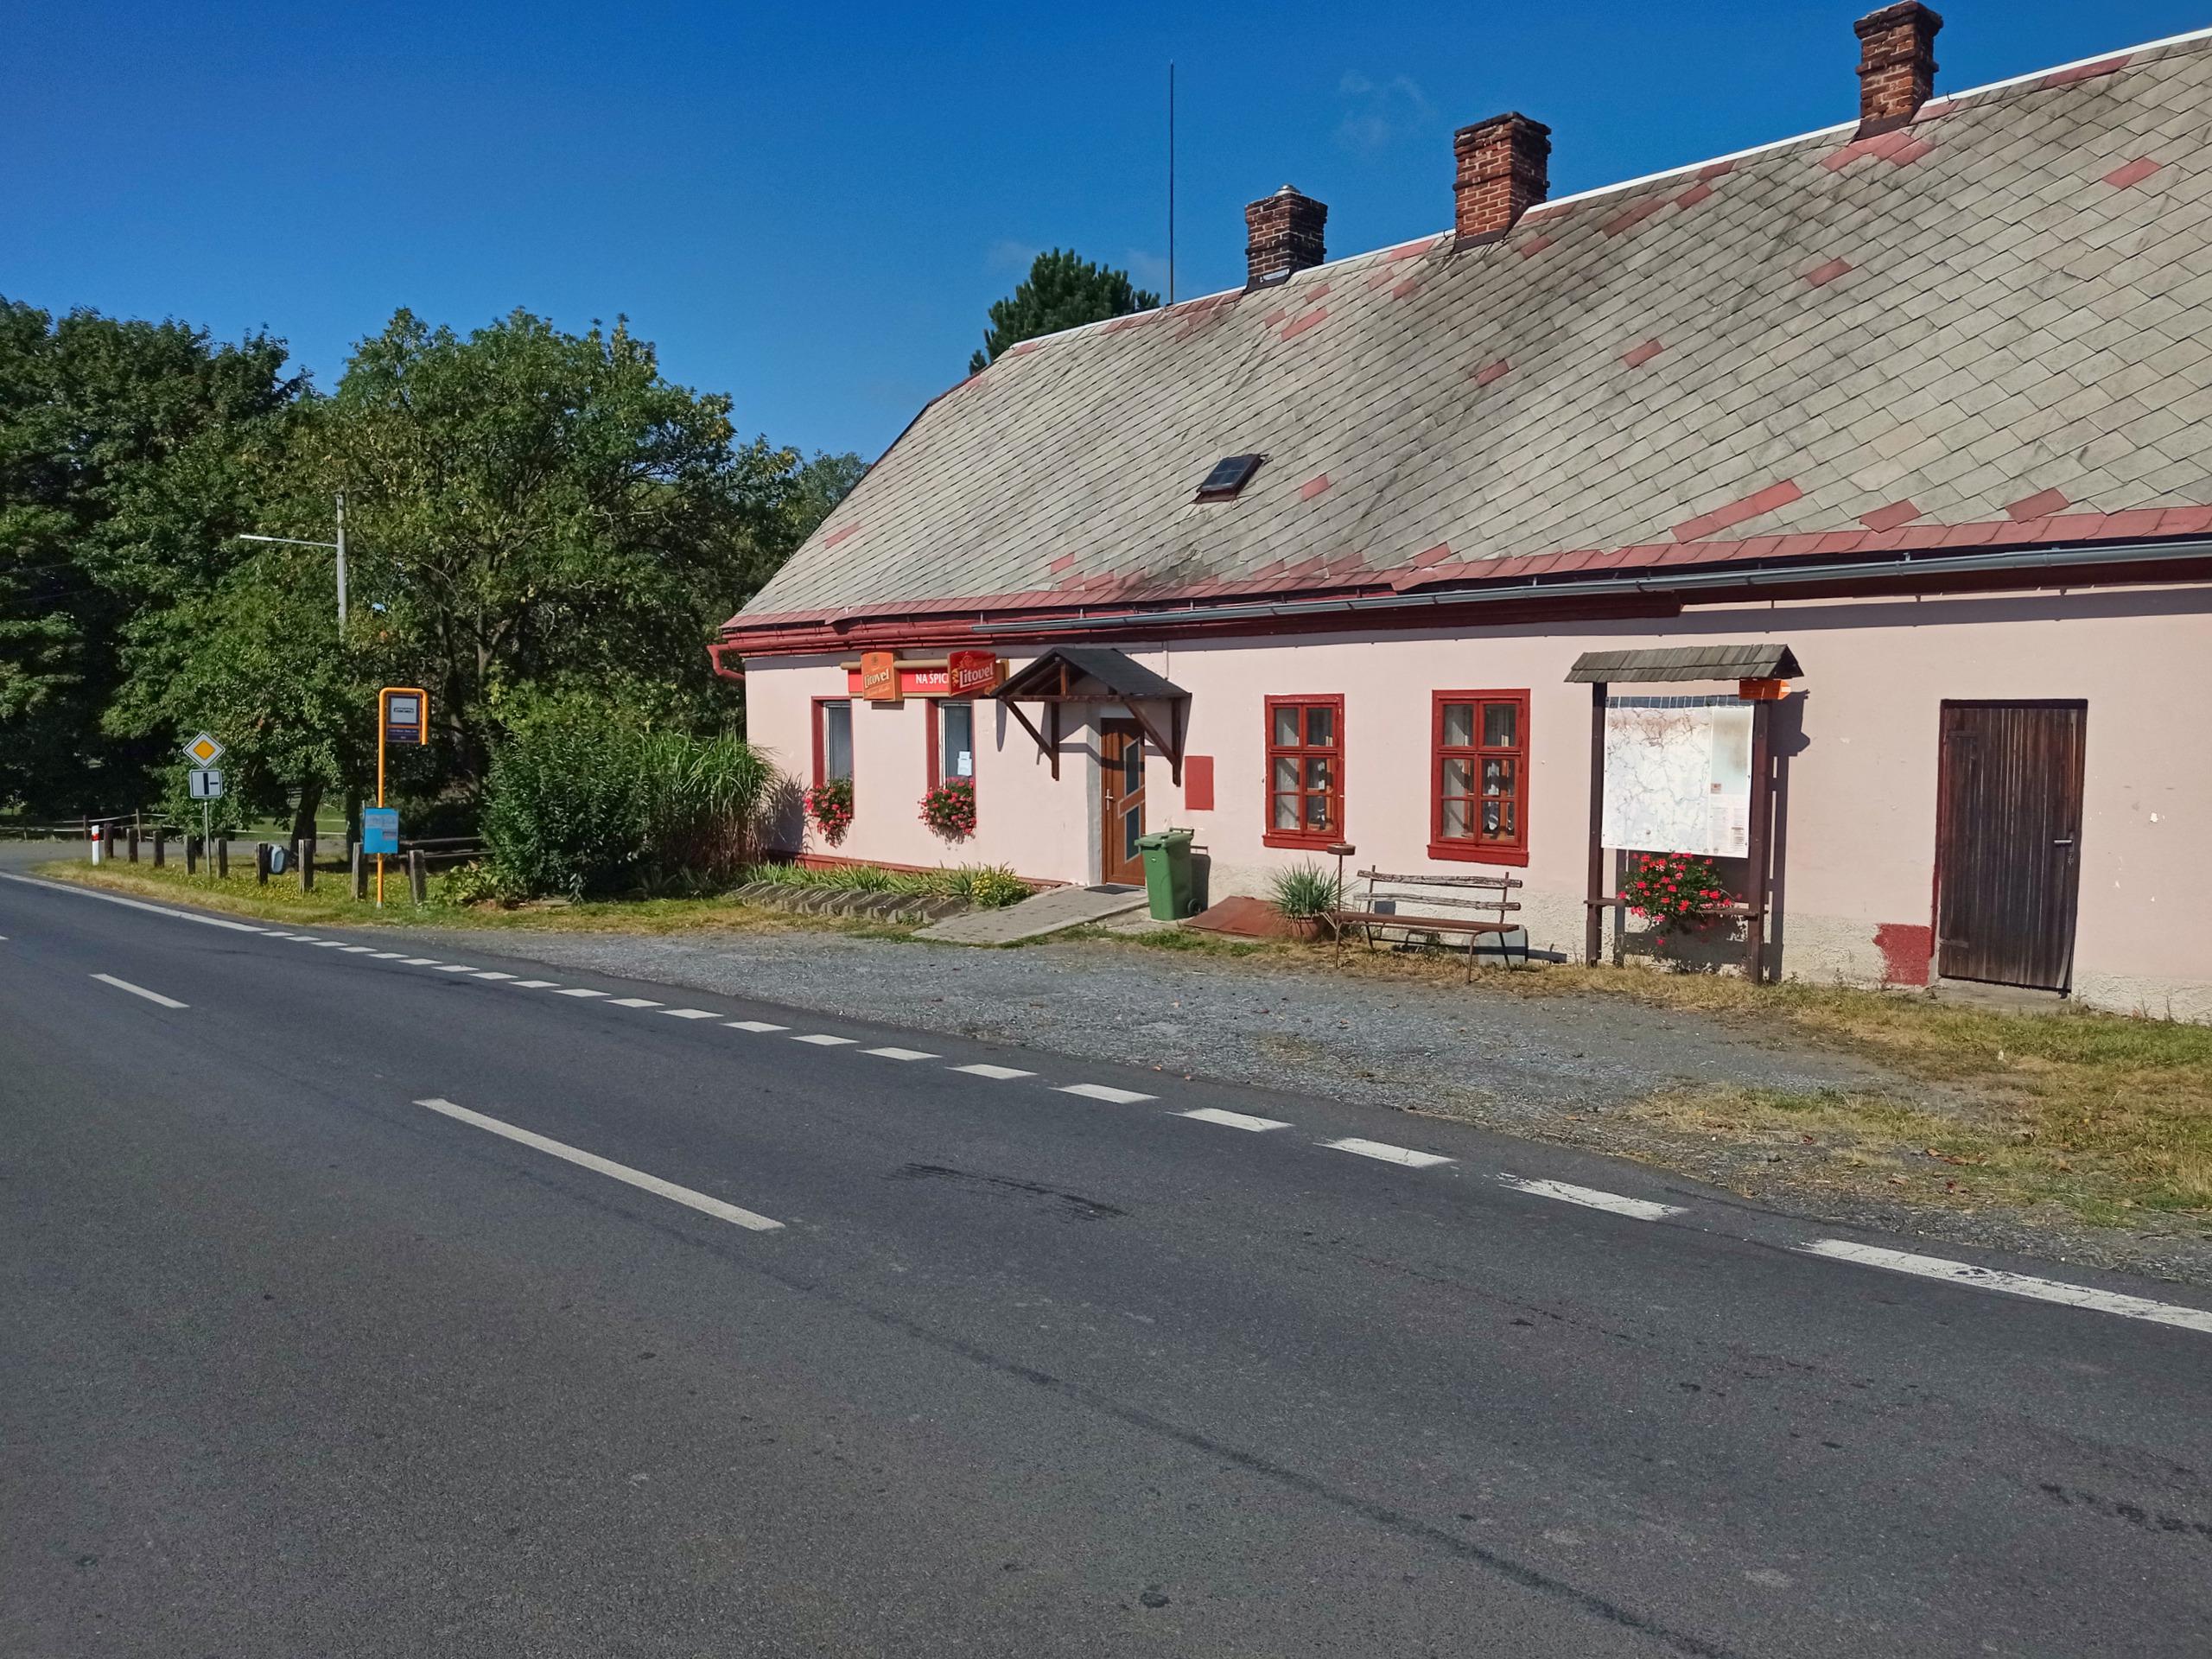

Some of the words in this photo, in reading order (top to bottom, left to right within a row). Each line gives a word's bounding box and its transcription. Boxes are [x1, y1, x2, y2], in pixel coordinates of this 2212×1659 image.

[864, 668, 889, 689] Litovel
[916, 673, 928, 684] NA
[930, 670, 949, 684] ŠPIC
[959, 662, 994, 688] Litovel
